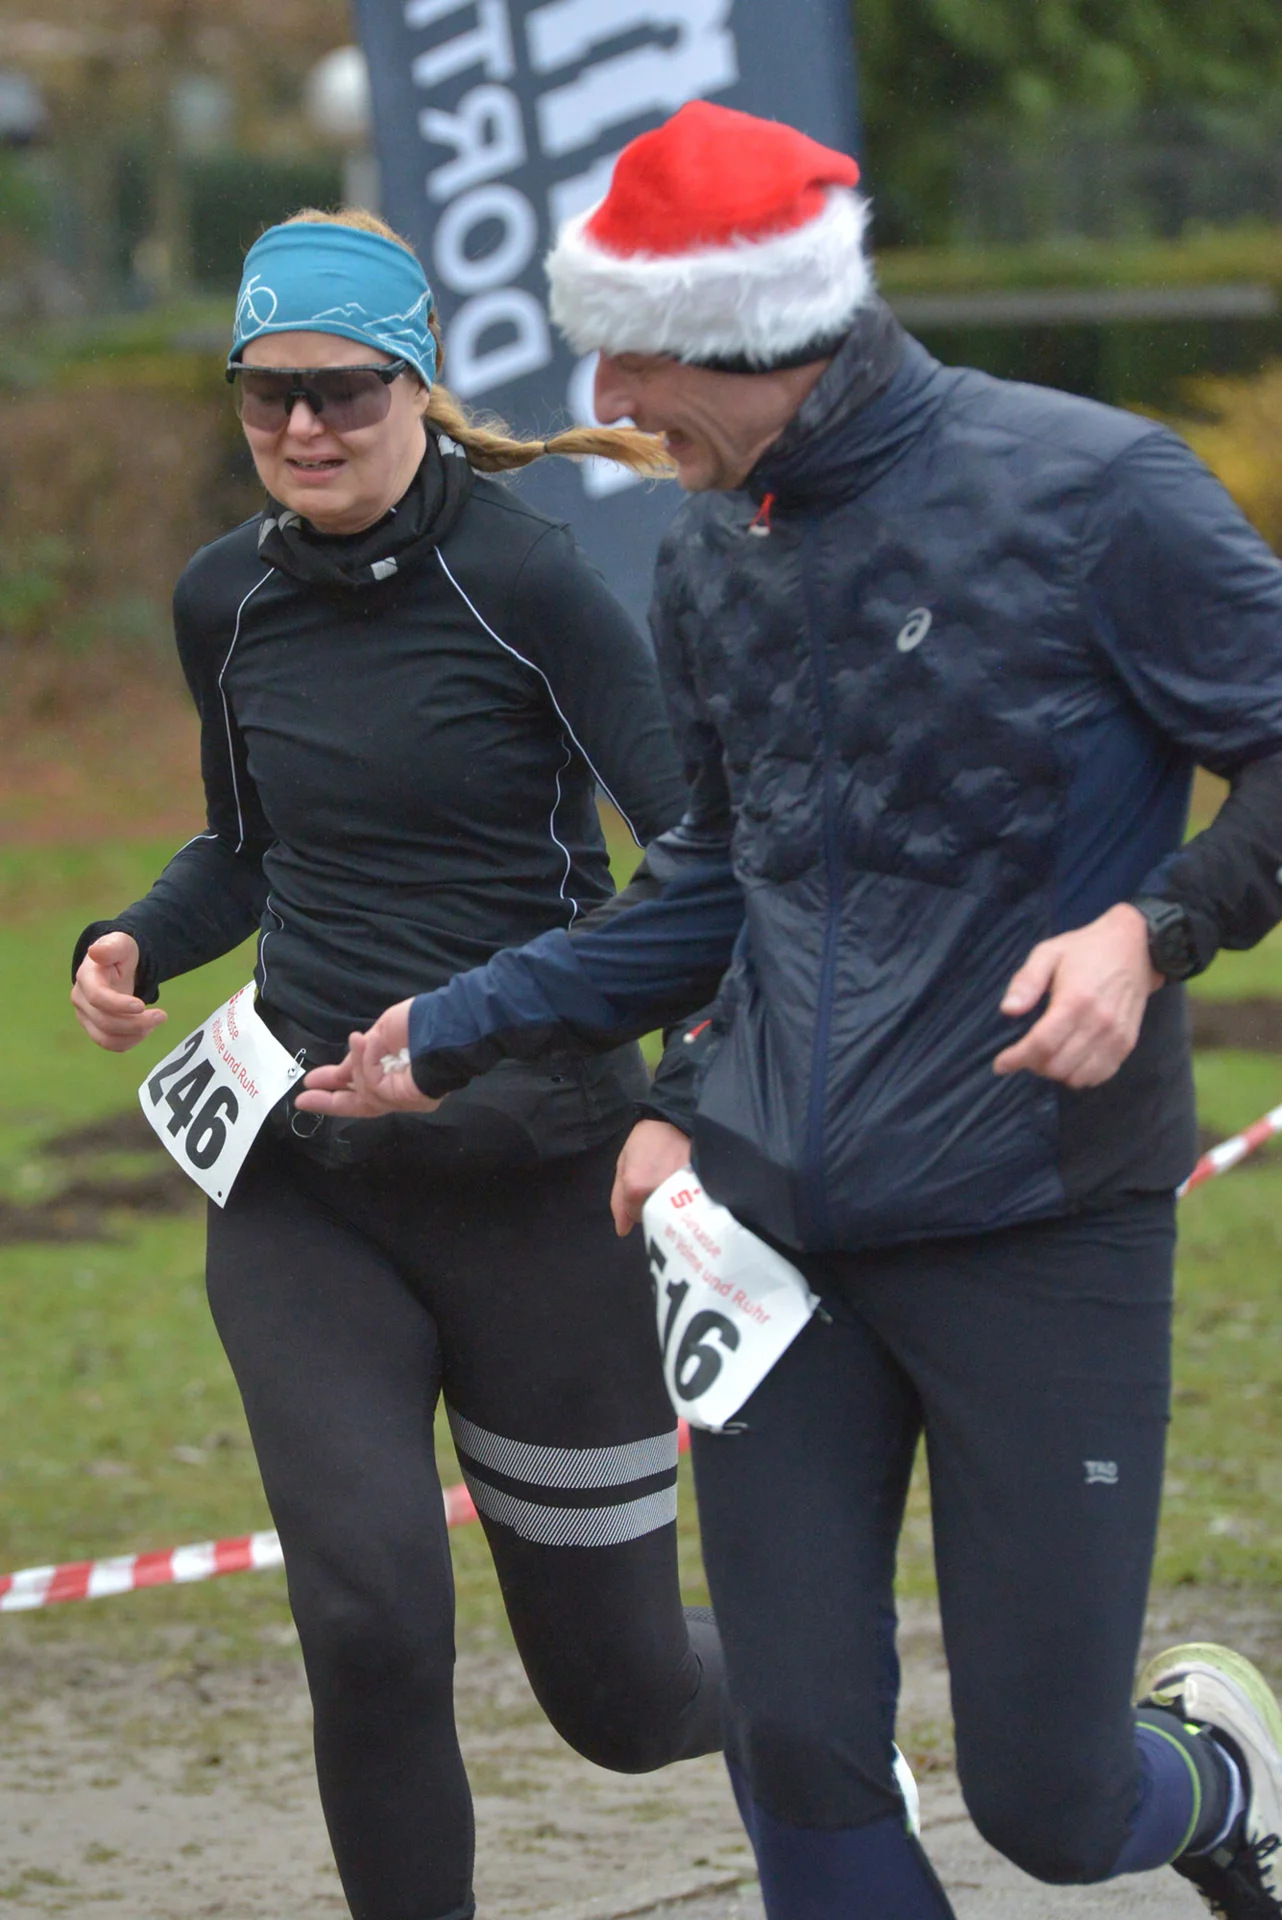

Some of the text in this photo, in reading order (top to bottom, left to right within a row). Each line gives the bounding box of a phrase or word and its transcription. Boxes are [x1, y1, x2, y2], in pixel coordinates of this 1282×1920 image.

[147, 1029, 239, 1170] 246
[223, 1050, 242, 1075] und
[237, 1068, 259, 1098] Ruhr
[702, 1269, 735, 1297] und
[731, 1288, 771, 1324] Ruhr
